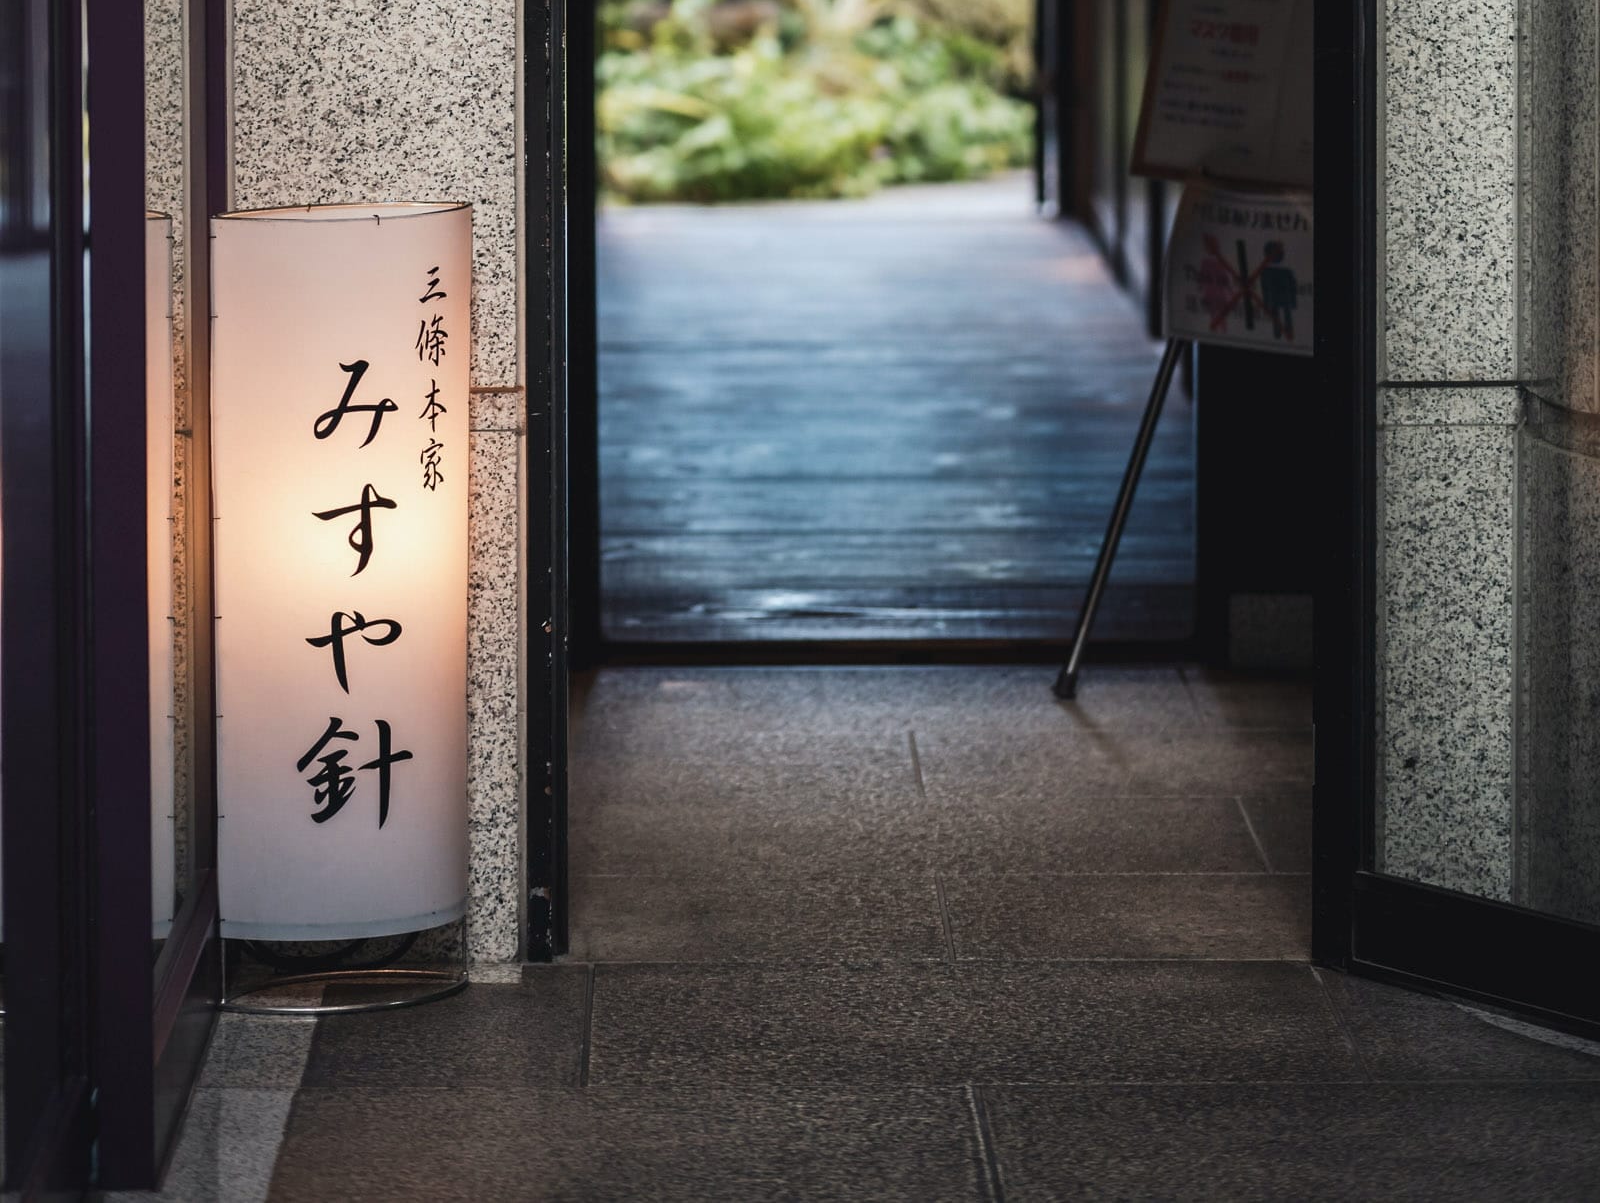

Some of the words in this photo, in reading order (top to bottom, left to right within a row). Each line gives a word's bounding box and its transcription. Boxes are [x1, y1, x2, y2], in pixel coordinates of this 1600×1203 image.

[415, 267, 449, 491] 三條本家
[297, 360, 414, 830] みすや針
